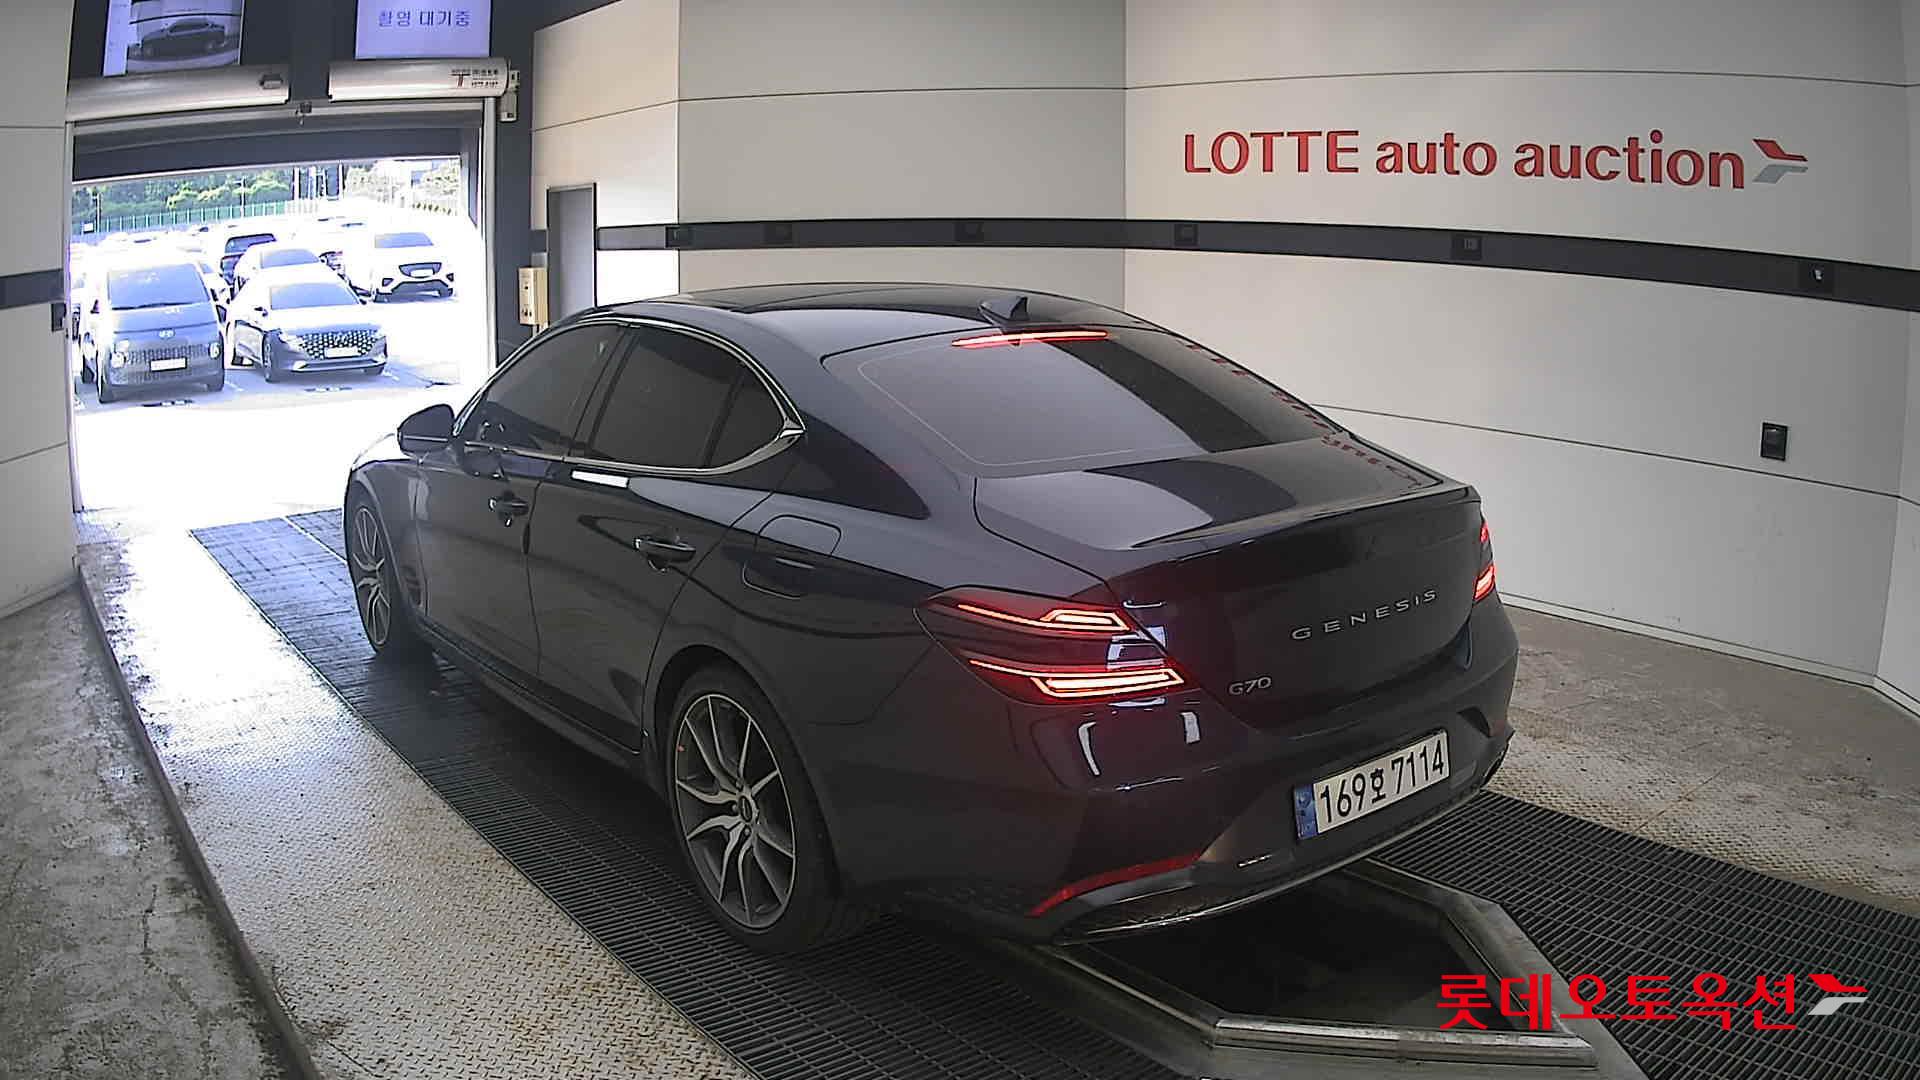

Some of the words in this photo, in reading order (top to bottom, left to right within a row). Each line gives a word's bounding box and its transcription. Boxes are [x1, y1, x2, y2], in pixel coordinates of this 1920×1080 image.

[419, 10, 470, 27] 대기중
[1184, 131, 1360, 174] LOTTE
[1376, 132, 1498, 176] auto
[1514, 130, 1745, 189] auction
[1292, 590, 1436, 639] GENESIS
[1229, 677, 1271, 695] G70
[1391, 740, 1444, 794] 7114
